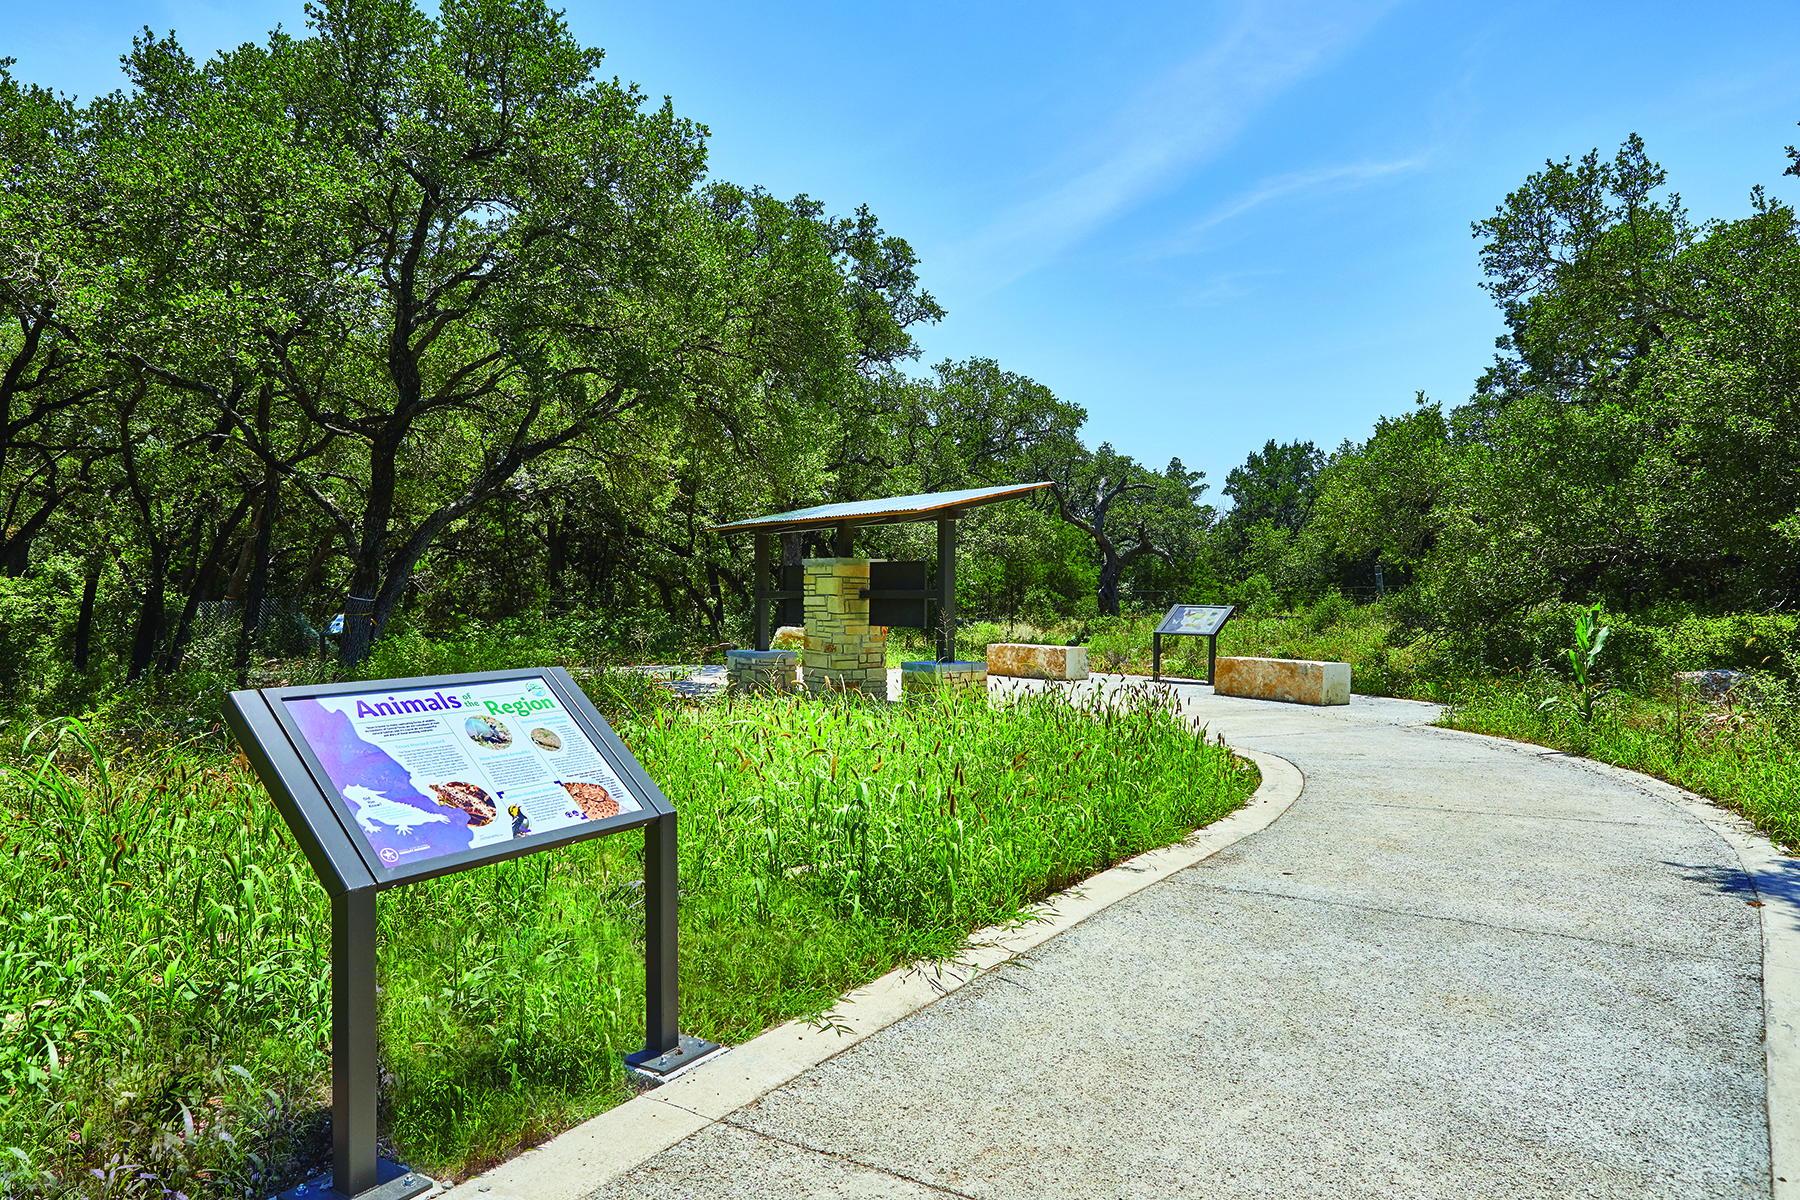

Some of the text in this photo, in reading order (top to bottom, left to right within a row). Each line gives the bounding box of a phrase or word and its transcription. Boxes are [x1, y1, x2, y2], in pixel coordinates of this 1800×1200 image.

[356, 692, 462, 718] Animals
[464, 700, 480, 708] the
[483, 697, 556, 717] Region
